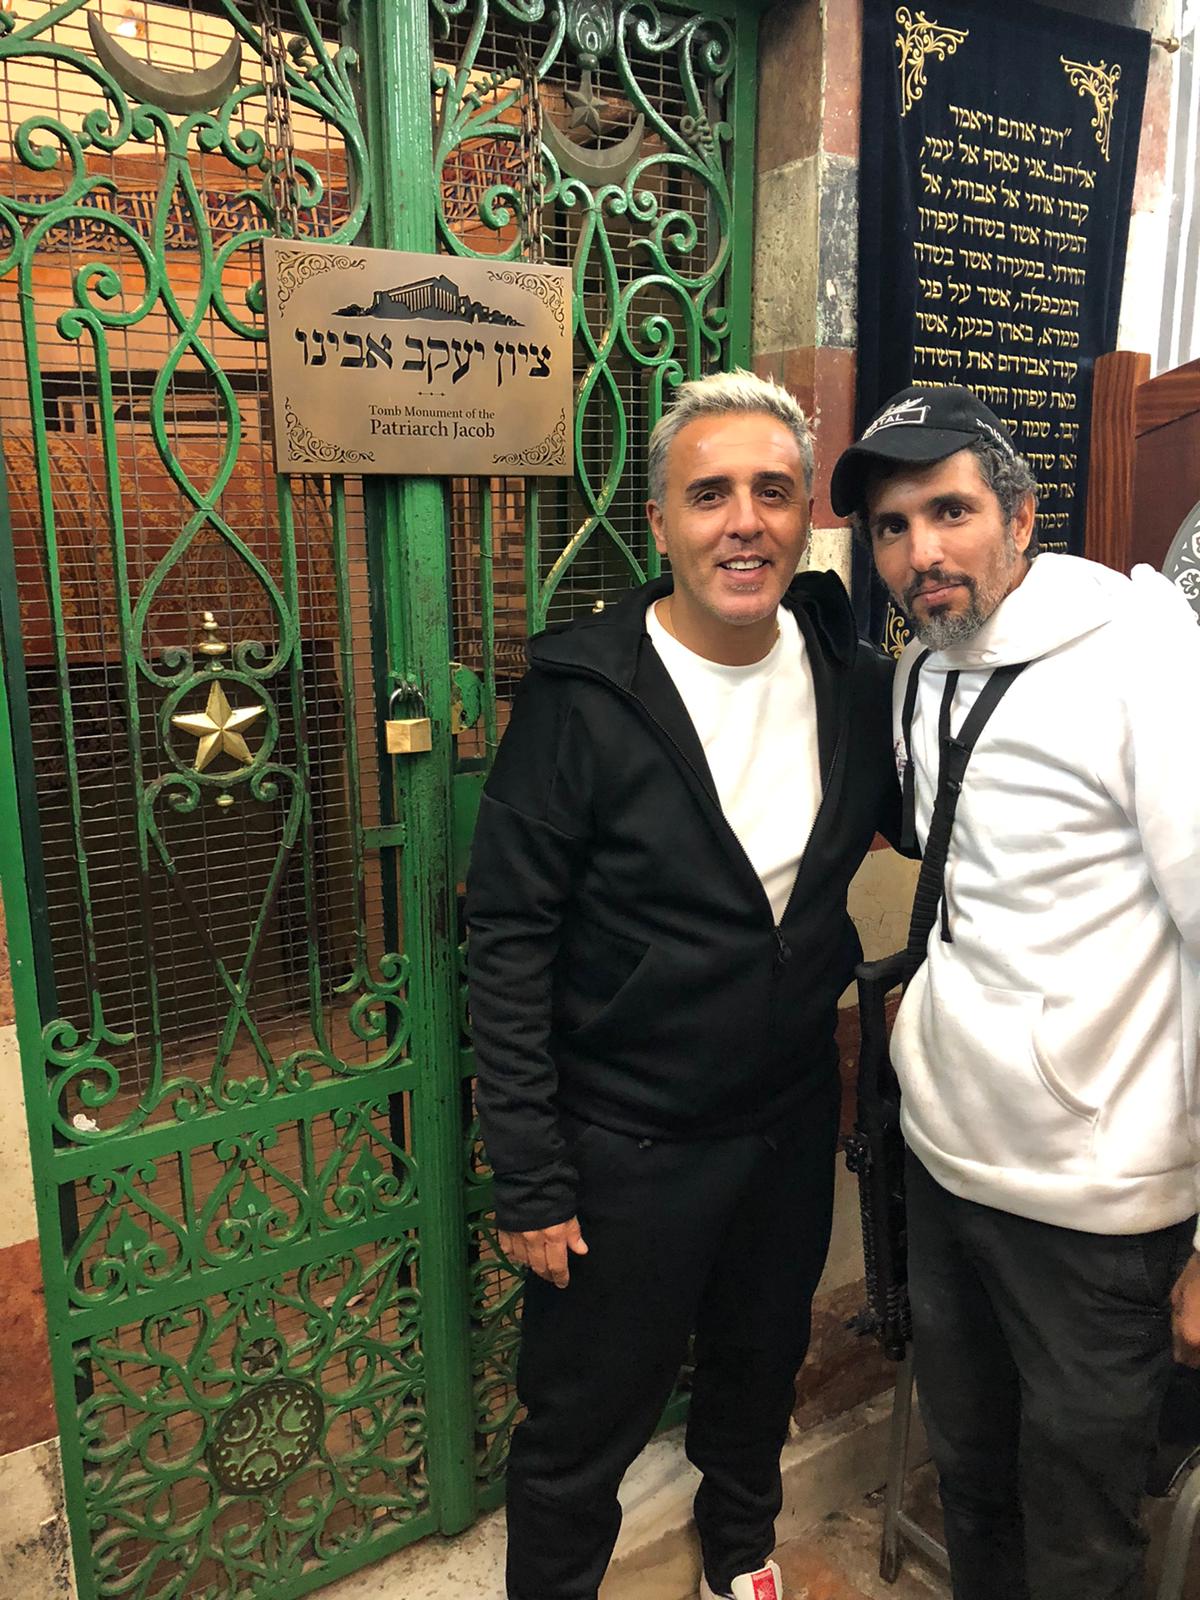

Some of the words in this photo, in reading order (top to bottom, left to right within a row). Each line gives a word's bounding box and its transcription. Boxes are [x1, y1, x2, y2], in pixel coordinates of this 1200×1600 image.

[949, 104, 993, 134] ויאמר
[998, 117, 1036, 143] אותם
[958, 134, 980, 165] אל
[984, 148, 1020, 174] נאסף
[920, 164, 942, 195] אל
[1000, 179, 1021, 209] אל
[1025, 192, 1055, 215] אותי
[918, 206, 958, 234] עפרון
[1058, 198, 1089, 227] קברו
[963, 214, 1006, 240] בשדה
[1010, 222, 1041, 245] אשר
[913, 241, 955, 266] בשדה
[1044, 229, 1087, 254] המערה
[959, 248, 993, 271] אשר
[997, 254, 1045, 279] במערה
[918, 277, 943, 300] פני
[948, 275, 971, 305] על
[977, 284, 1011, 308] אשר
[915, 311, 948, 334] אשר
[997, 320, 1034, 344] בארץ
[295, 327, 393, 370] אבינו
[402, 334, 485, 384] יעקב
[913, 345, 962, 369] השדה
[965, 349, 996, 370] את
[494, 339, 552, 387] ציון
[998, 353, 1049, 376] אברהם
[1052, 359, 1078, 384] קנה
[1011, 386, 1048, 410] עפרון
[1050, 390, 1077, 410] מאת
[368, 404, 401, 416] Tomb
[404, 406, 463, 418] Monument
[465, 408, 477, 419] of
[478, 409, 495, 420] the
[370, 419, 448, 437] Patriarch
[453, 421, 495, 439] Jacob
[1022, 420, 1051, 439] שמה
